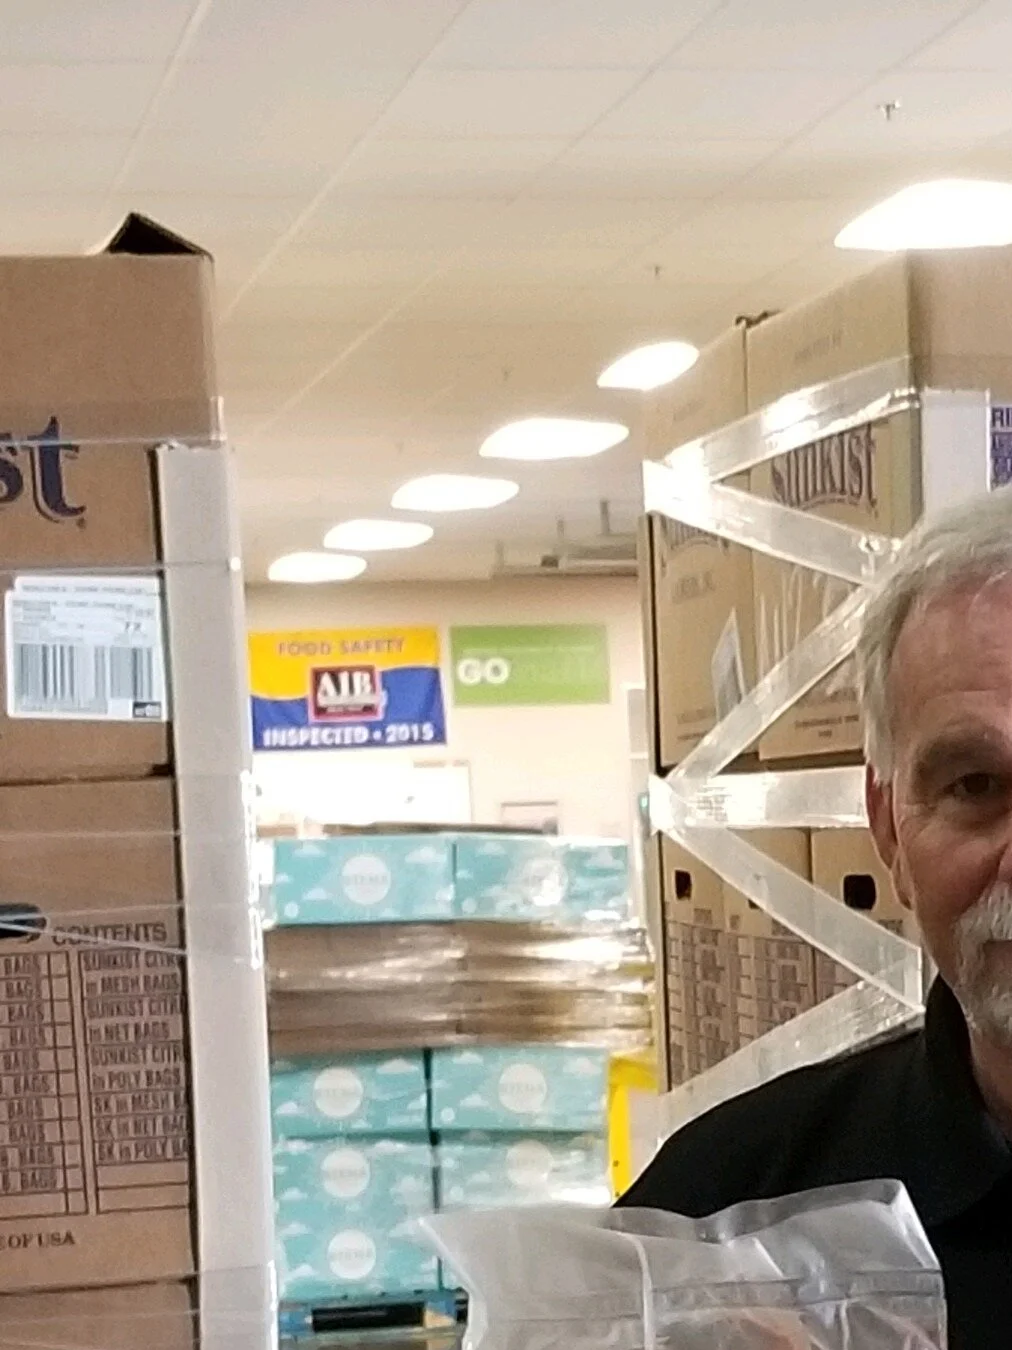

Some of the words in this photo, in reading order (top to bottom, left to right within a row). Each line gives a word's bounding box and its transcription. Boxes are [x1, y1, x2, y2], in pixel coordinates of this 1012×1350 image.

[279, 641, 331, 656] FOOD
[340, 637, 405, 653] SAFETY
[458, 658, 510, 685] GO
[318, 671, 373, 702] AIB
[263, 727, 368, 747] INSPECTED
[385, 724, 434, 744] 2015
[53, 922, 168, 946] CONTENTS
[105, 1025, 130, 1043] NET
[135, 1024, 170, 1042] BAGS
[109, 1073, 141, 1091] POLY
[145, 1072, 180, 1090] BAGS
[35, 1231, 76, 1247] USA
